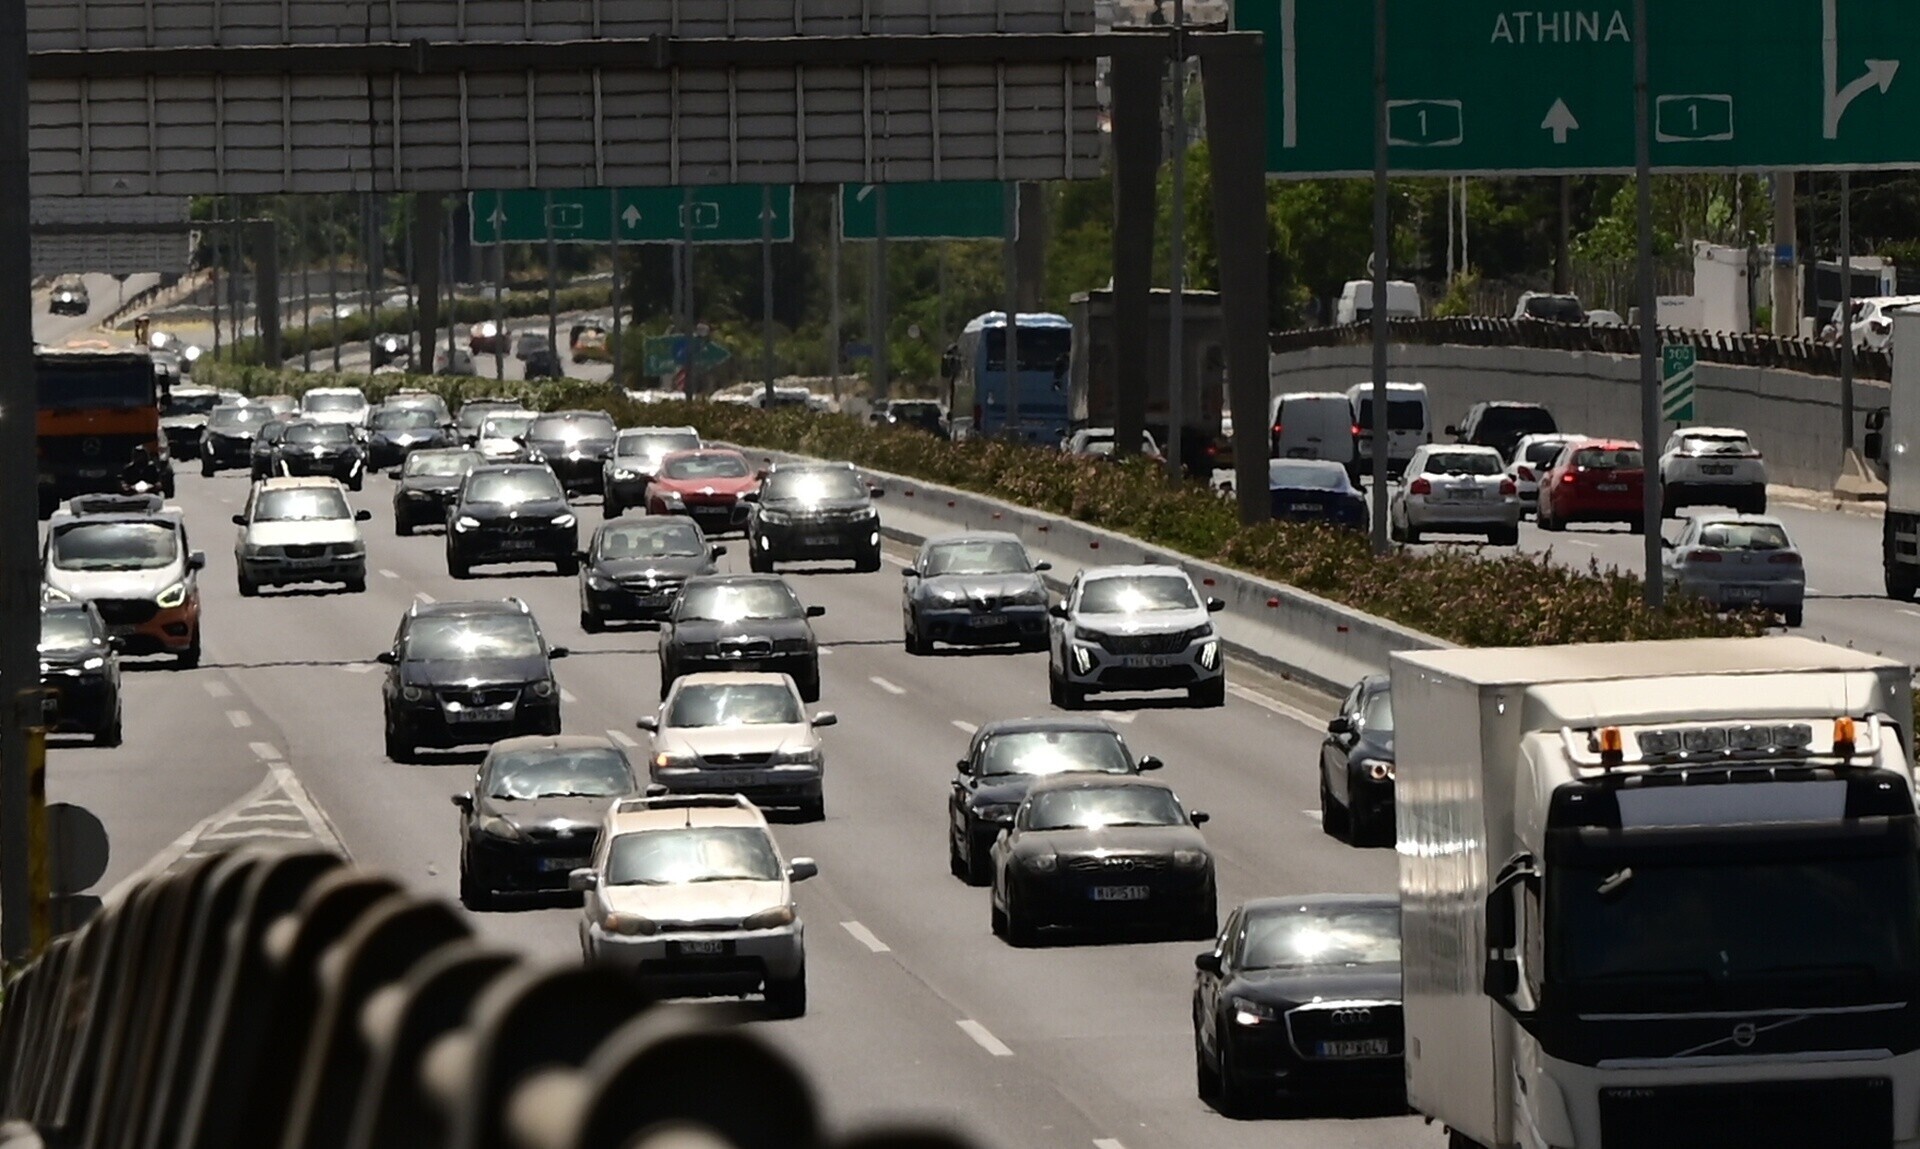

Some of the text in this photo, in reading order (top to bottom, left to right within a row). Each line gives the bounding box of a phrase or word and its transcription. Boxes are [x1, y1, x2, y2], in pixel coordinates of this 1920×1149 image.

[1490, 9, 1631, 44] ATHINA
[1417, 109, 1427, 137] 1
[1687, 103, 1698, 131] 1
